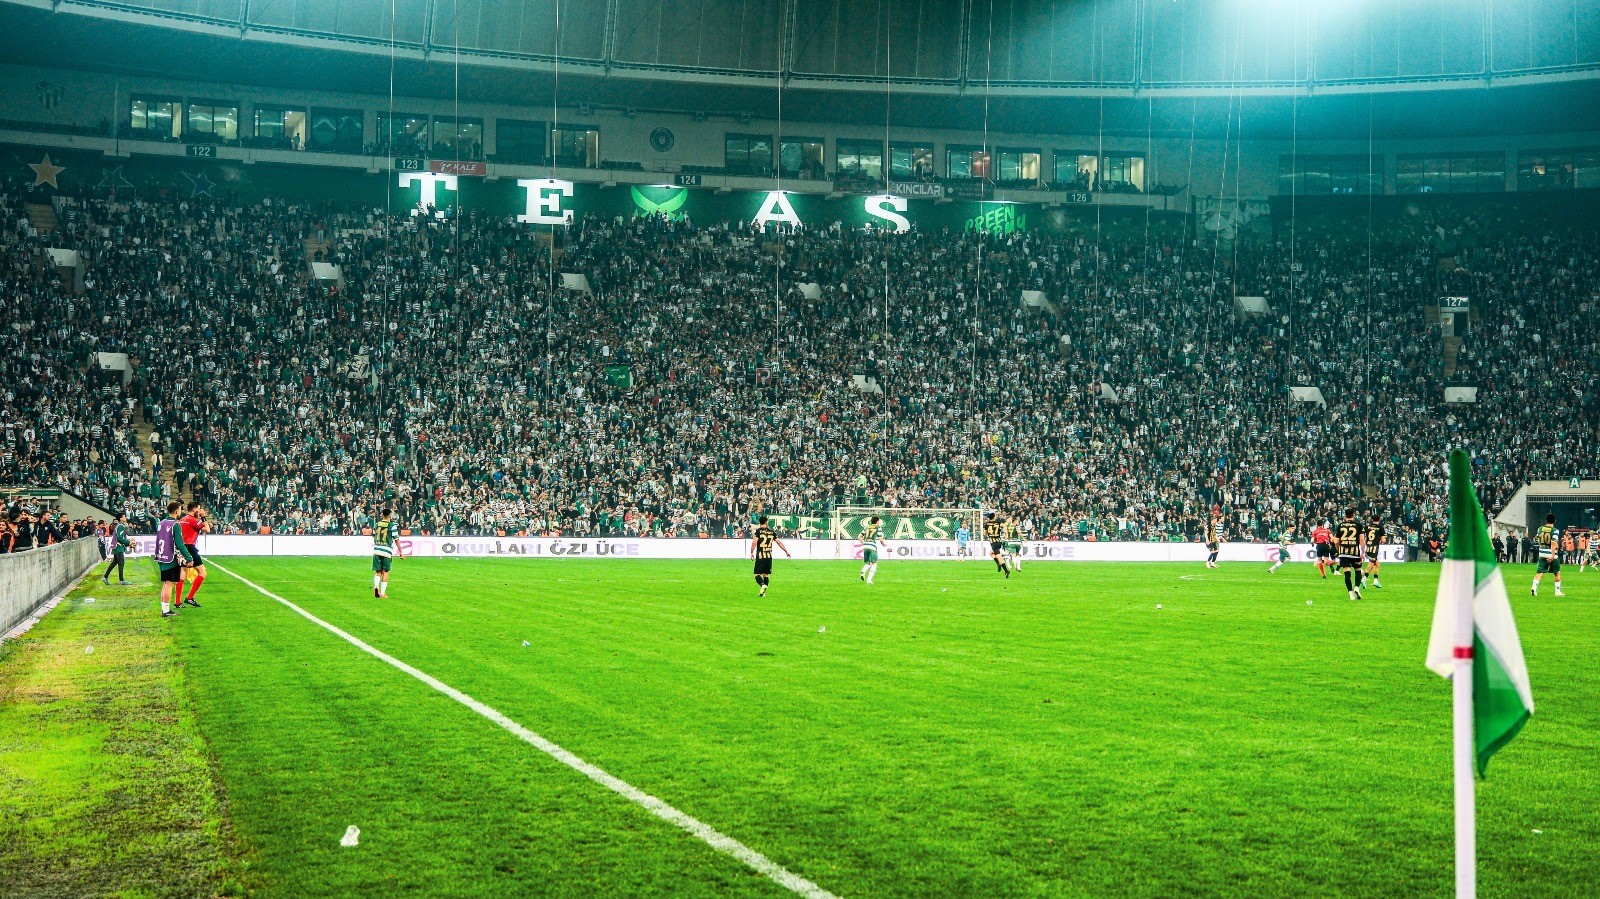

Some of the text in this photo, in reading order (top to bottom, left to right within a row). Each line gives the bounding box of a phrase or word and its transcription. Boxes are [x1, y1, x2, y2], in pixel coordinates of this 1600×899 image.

[193, 147, 210, 156] 122
[401, 159, 418, 170] 123
[680, 175, 696, 185] 124
[1071, 192, 1087, 202] 126
[1446, 297, 1461, 307] 127
[1569, 477, 1579, 488] A
[1340, 527, 1357, 541] 22
[1368, 530, 1375, 541] 6
[759, 533, 774, 548] 27
[442, 541, 541, 554] OKULLARI
[550, 539, 640, 555] ÖZLÜCE
